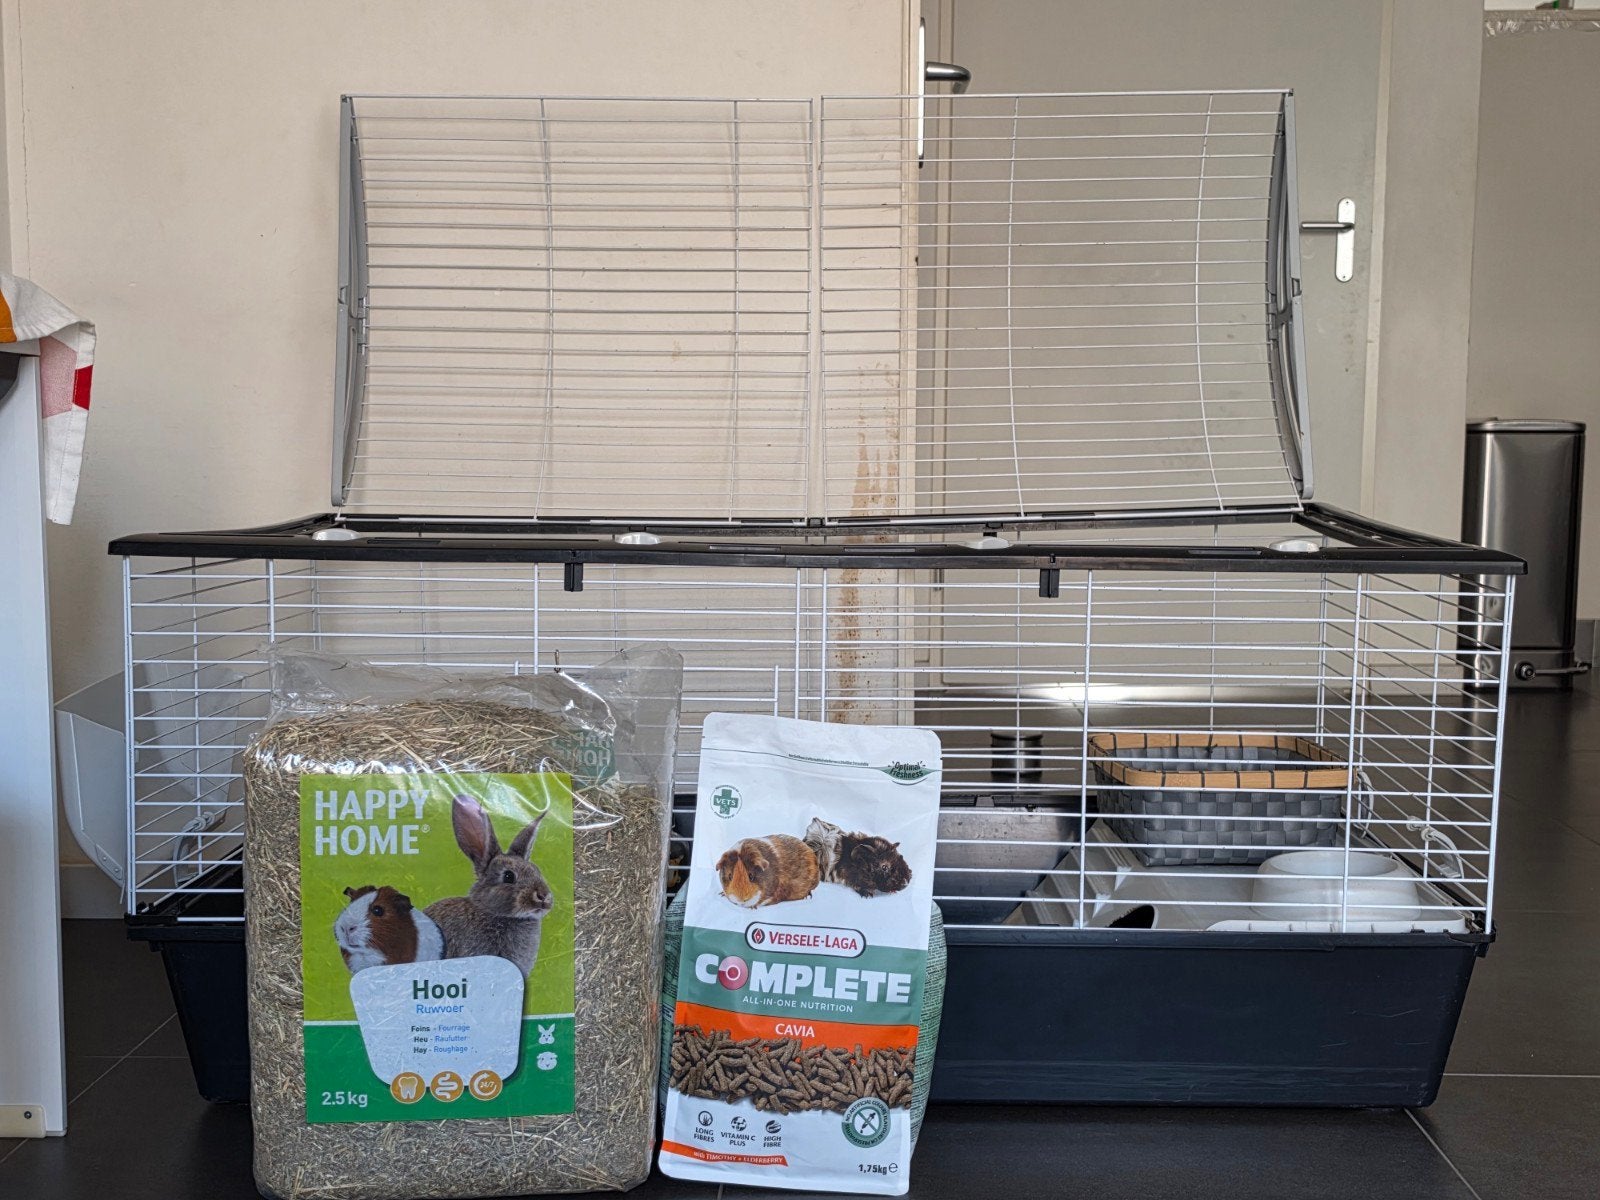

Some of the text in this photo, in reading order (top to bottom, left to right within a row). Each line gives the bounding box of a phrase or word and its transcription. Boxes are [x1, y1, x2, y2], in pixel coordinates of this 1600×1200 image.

[894, 761, 921, 771] Optimal
[314, 789, 431, 821] HAPPY
[715, 797, 737, 806] VETS
[769, 931, 858, 951] VERSELE-LAGA
[694, 953, 912, 1004] COMPLETE
[412, 977, 468, 1000] Hooi
[416, 1004, 465, 1014] Ruwvoer
[742, 995, 854, 1013] ALL-IN-ONE NUTRITION
[438, 1024, 471, 1033] Fourrage
[775, 1023, 816, 1038] CAVIA
[413, 1046, 428, 1055] Hay
[433, 1045, 469, 1053] Roughage
[695, 1127, 714, 1136] LONG
[720, 1132, 750, 1141] VITAMIN
[693, 1133, 715, 1143] FIBRES
[729, 1139, 746, 1147] PLUS
[705, 1152, 737, 1161] TIMOTHY
[858, 1164, 888, 1176] 1,75kg
